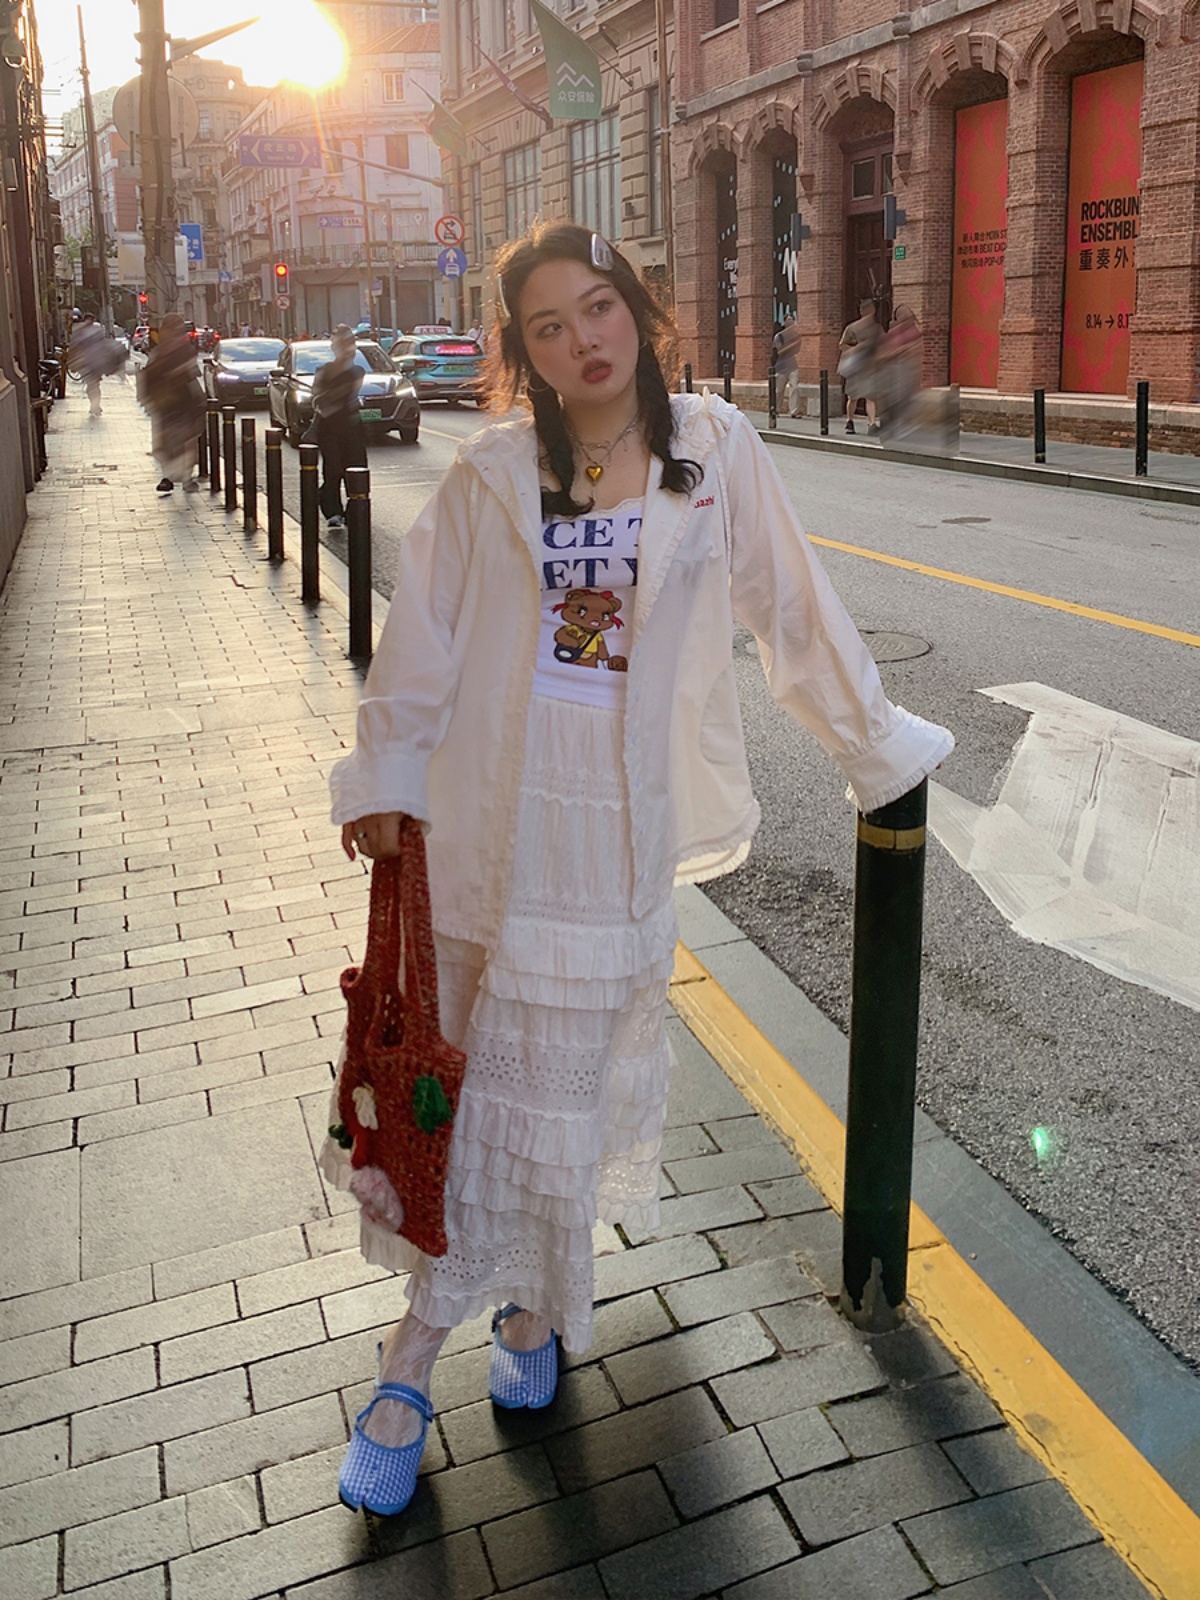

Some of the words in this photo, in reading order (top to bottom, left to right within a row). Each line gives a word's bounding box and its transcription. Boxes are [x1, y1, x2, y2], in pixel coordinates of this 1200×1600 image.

[558, 91, 595, 103] 众安保险
[1082, 196, 1140, 221] ROCKBUN
[1081, 220, 1138, 243] ENSEMBL
[1086, 313, 1102, 329] 8.14
